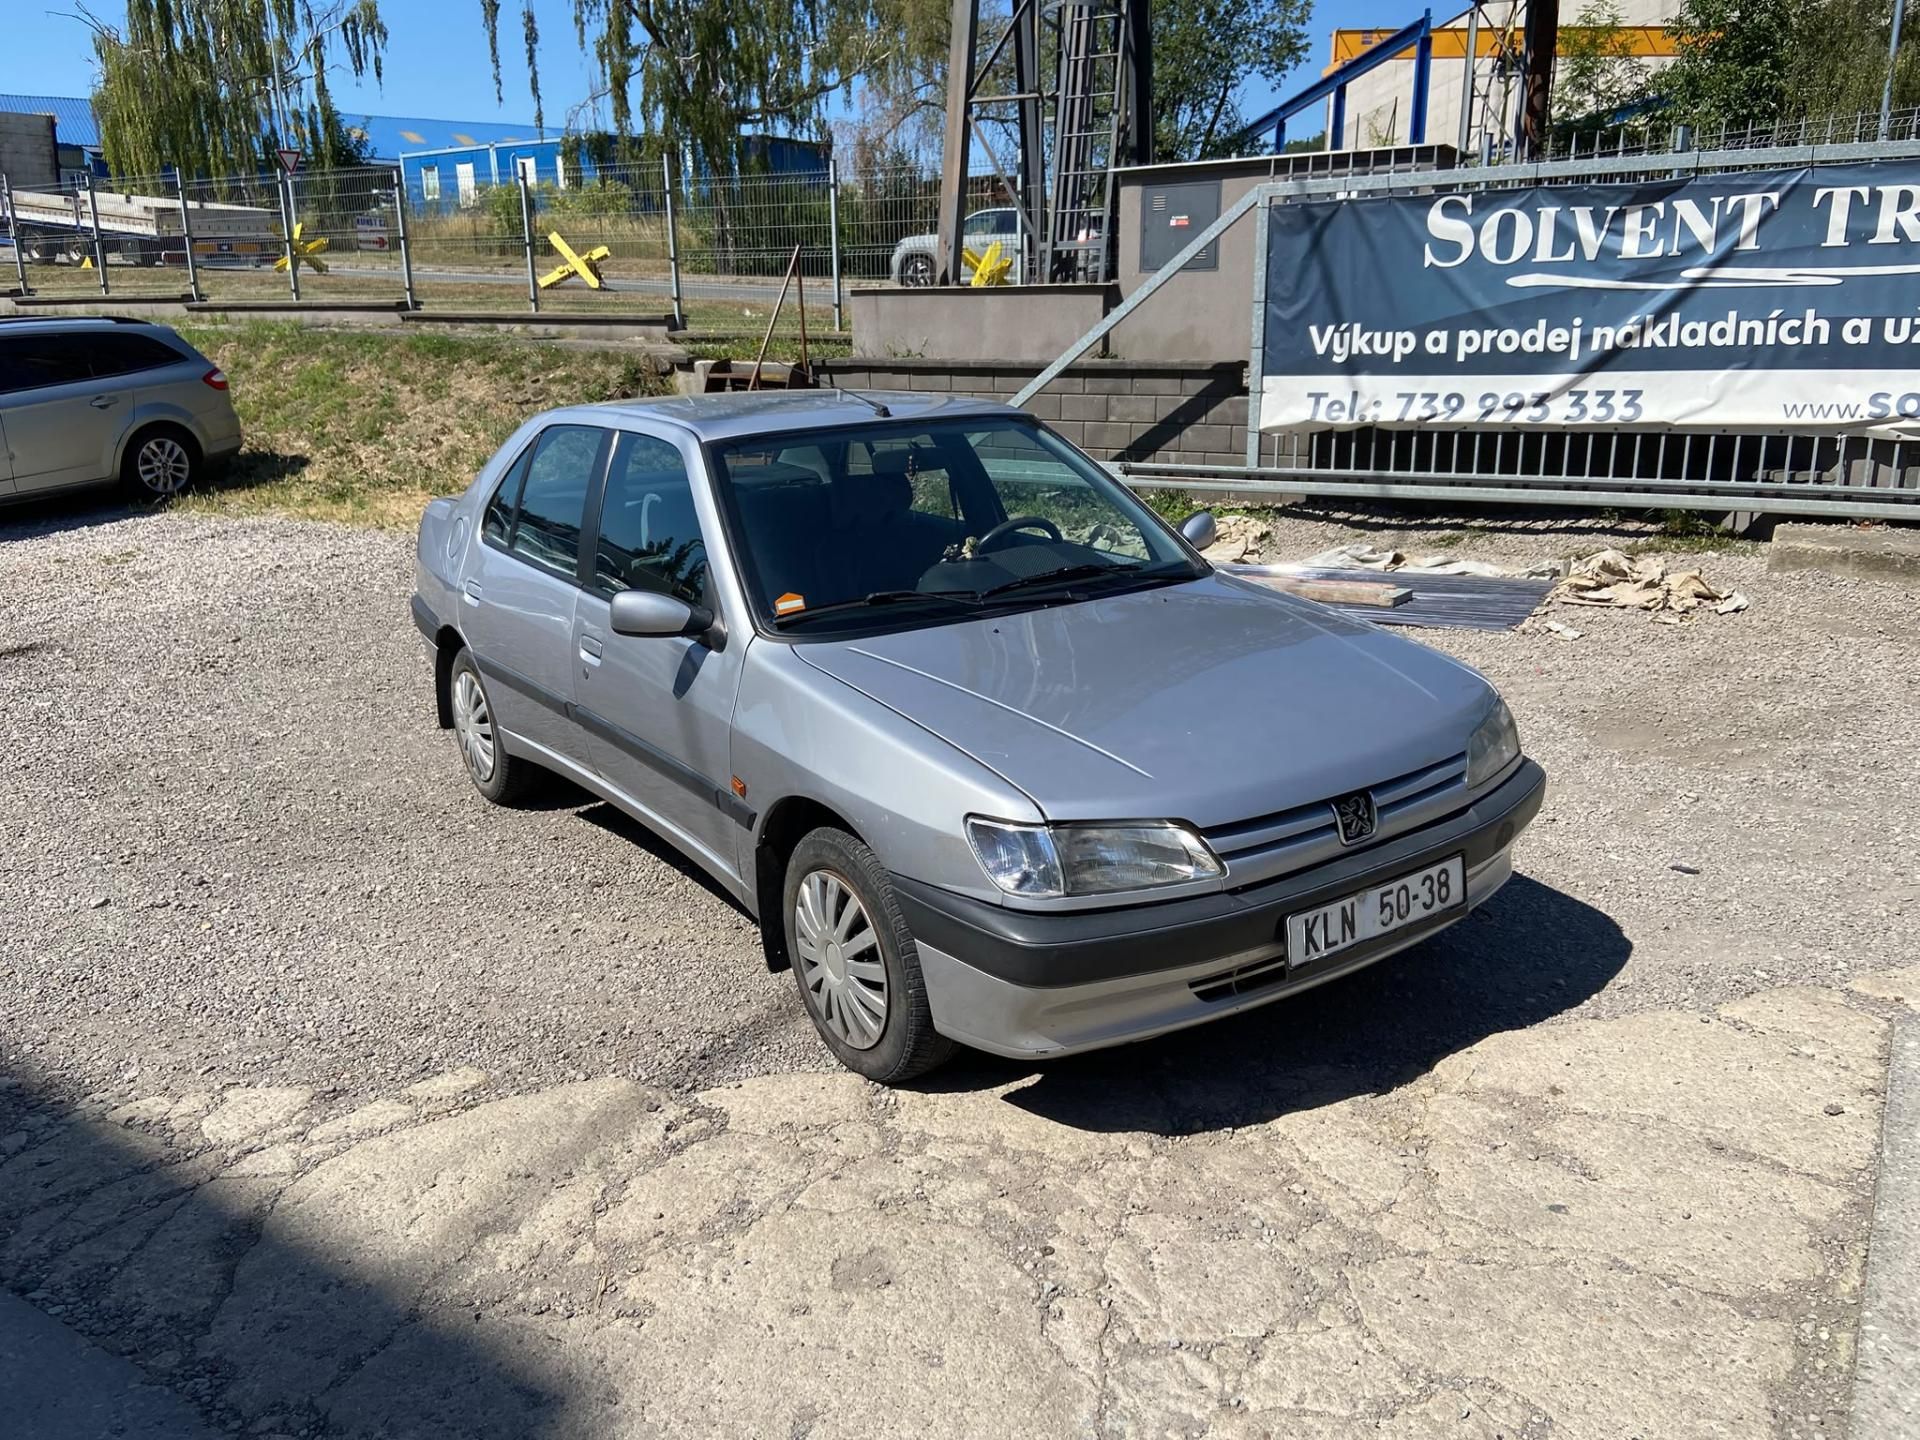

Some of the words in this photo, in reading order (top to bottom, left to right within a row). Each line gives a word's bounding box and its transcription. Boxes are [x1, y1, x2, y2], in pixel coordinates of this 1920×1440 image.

[1424, 191, 1780, 269] SOLVENT
[1812, 184, 1920, 247] TR
[1308, 322, 1417, 363] Výkup
[1424, 329, 1449, 354] a
[1456, 316, 1584, 362] prodej
[1590, 308, 1831, 351] nákladních
[1841, 317, 1872, 345] a
[1306, 390, 1382, 422] Tel.:
[1395, 392, 1466, 422] 739
[1478, 391, 1552, 423] 993
[1563, 389, 1645, 422] 333
[1303, 902, 1356, 957] KLN
[1378, 868, 1451, 928] 50-38
